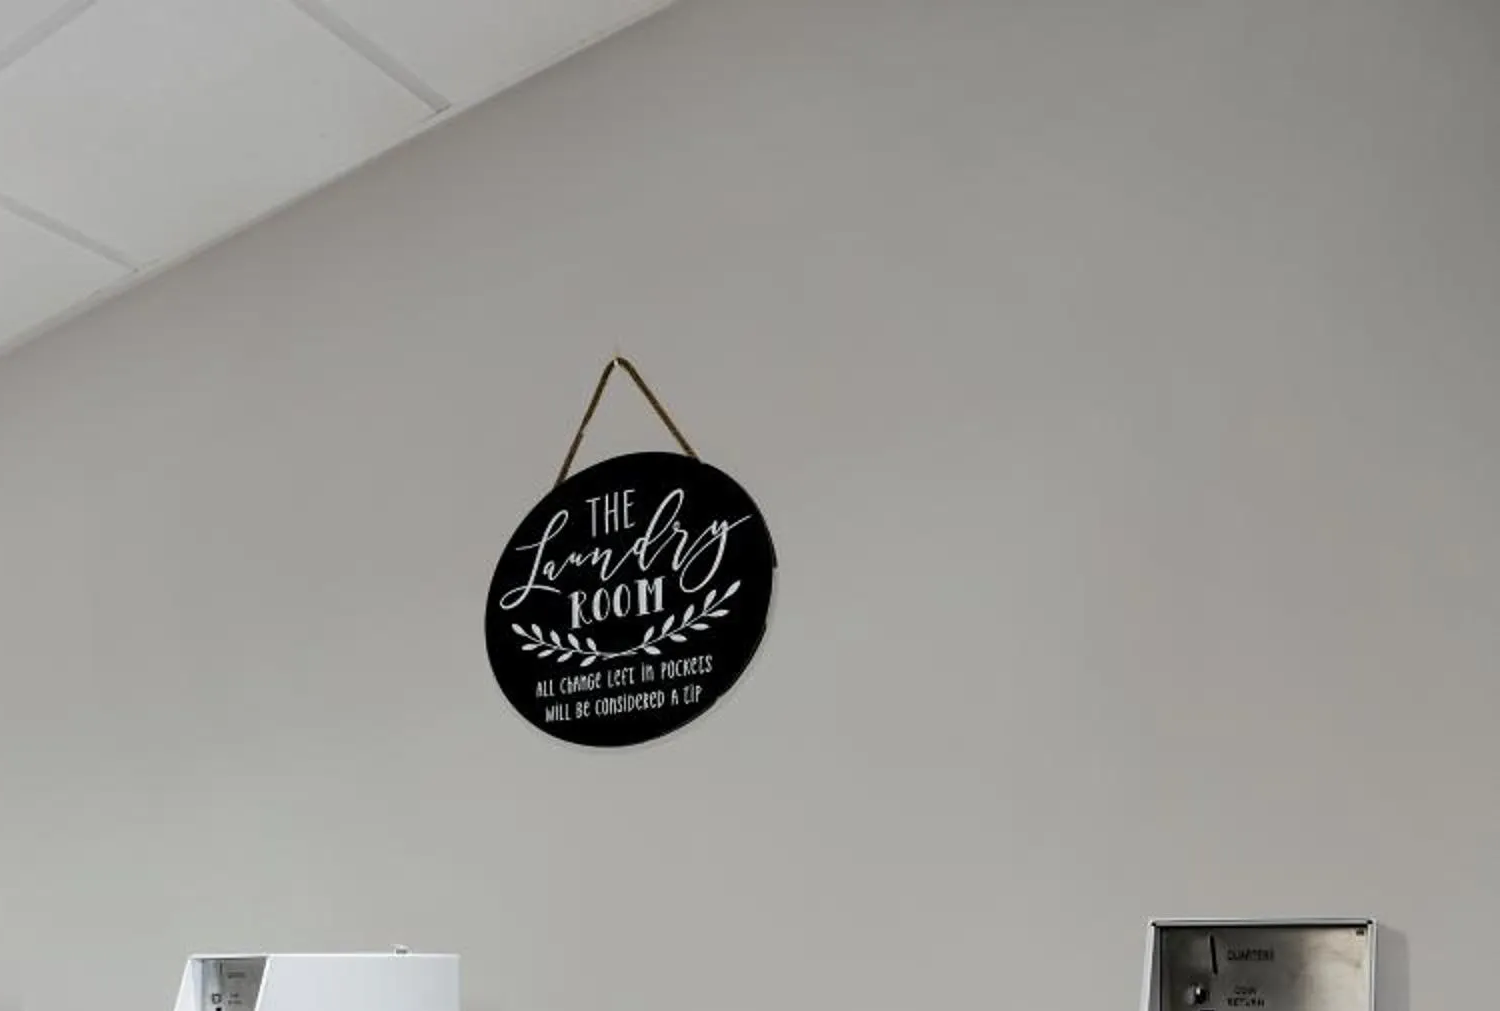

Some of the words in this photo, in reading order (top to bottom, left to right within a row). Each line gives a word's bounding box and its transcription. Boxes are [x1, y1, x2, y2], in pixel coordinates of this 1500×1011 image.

[585, 489, 636, 538] THE
[499, 488, 751, 611] Laundry
[568, 576, 666, 629] ROOM
[535, 679, 555, 698] ALL
[671, 688, 679, 706] A
